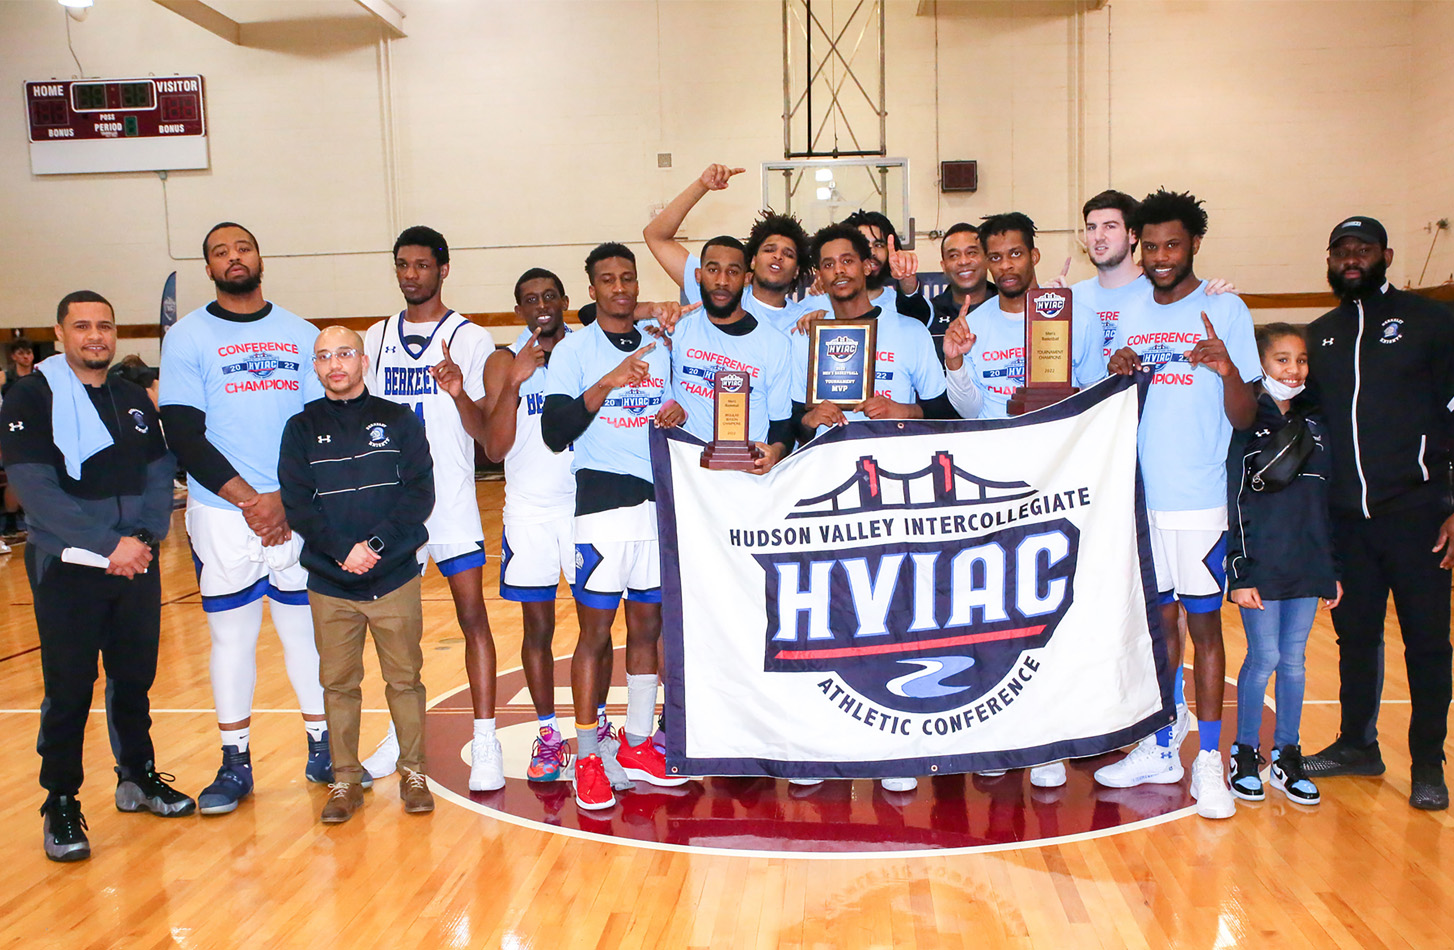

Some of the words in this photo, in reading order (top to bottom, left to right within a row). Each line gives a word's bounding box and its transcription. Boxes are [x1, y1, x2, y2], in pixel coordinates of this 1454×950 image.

[33, 85, 64, 97] HOME
[157, 80, 198, 93] VISITOR
[48, 128, 75, 137] BONUS
[94, 123, 123, 132] PERIOD
[158, 124, 185, 133] BONUS
[1037, 301, 1064, 309] HVIAC
[1127, 332, 1202, 346] CONFERENCE
[218, 342, 299, 357] CONFERENCE
[828, 344, 857, 354] HVIAC
[686, 348, 760, 378] CONFERENCE
[1144, 352, 1173, 362] HVIAC
[230, 364, 241, 372] 20
[249, 360, 277, 370] HVIAC
[225, 379, 299, 394] CHAMPIONS
[729, 525, 812, 548] HUDSON
[819, 518, 895, 544] VALLEY
[905, 486, 1092, 536] INTERCOLLEGIATE
[771, 529, 1072, 643] HVIAC
[817, 677, 911, 736] ATHLETIC
[922, 655, 1043, 736] CONFERENCE
